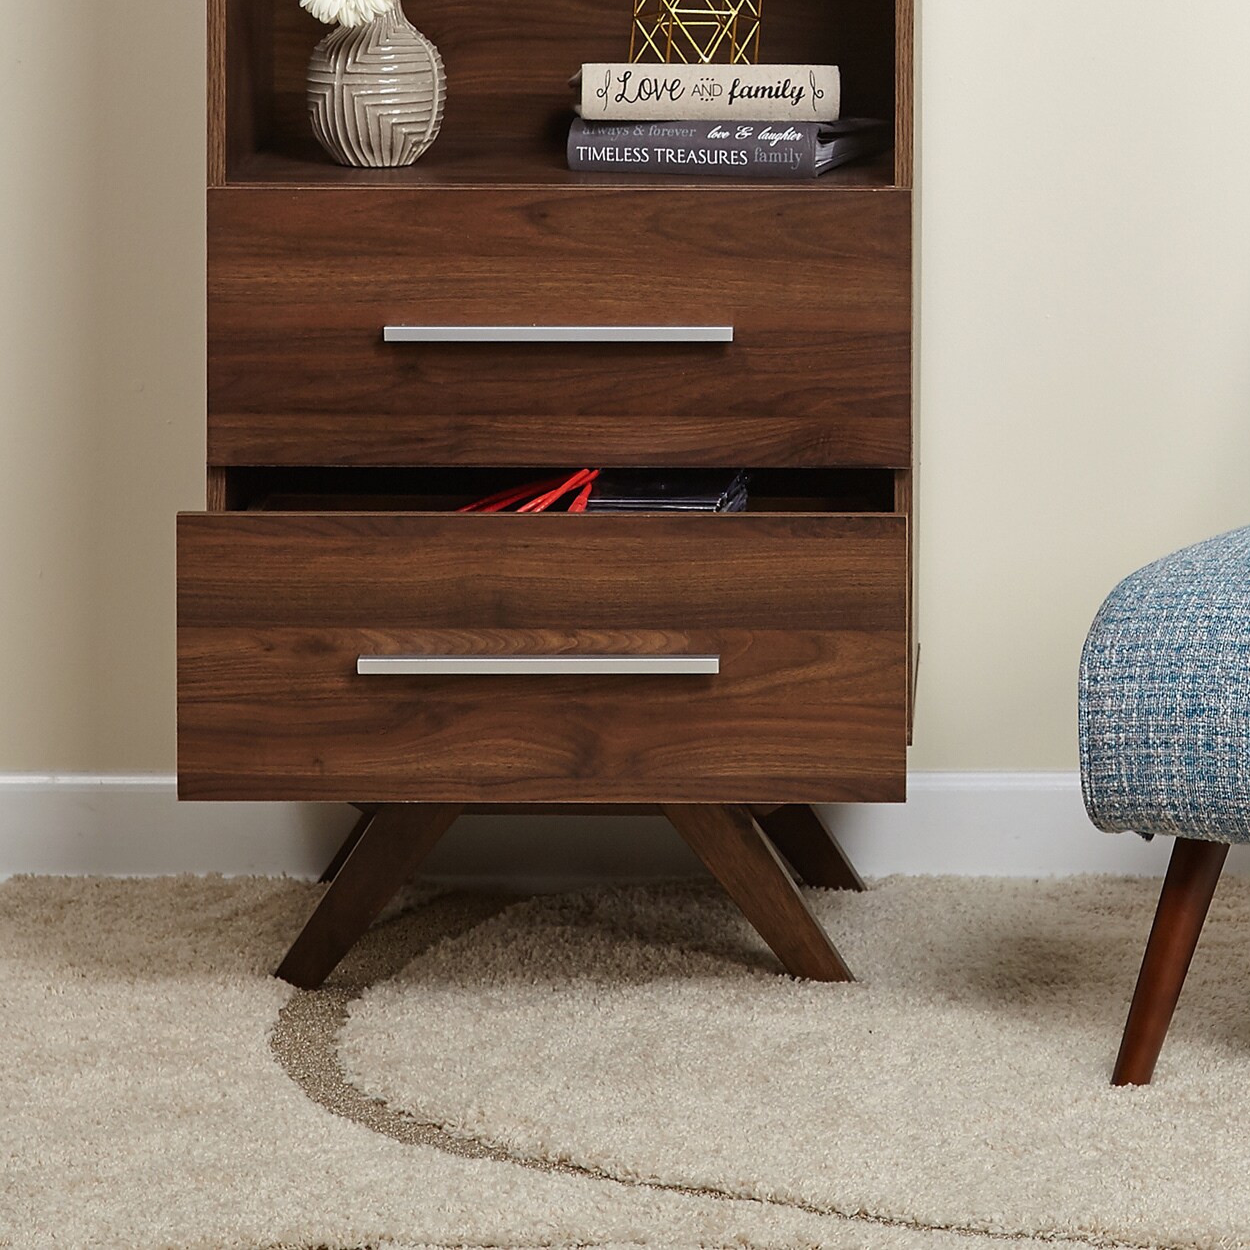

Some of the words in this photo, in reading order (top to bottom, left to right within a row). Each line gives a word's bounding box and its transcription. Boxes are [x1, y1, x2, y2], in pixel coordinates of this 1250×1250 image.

[615, 71, 685, 104] Love
[691, 83, 723, 97] AND
[728, 78, 806, 105] family
[633, 125, 645, 136] &
[649, 124, 697, 137] forever
[707, 125, 730, 139] love
[735, 125, 754, 140] &
[757, 126, 803, 147] laughter
[576, 146, 650, 163] TIMELESS
[653, 148, 748, 165] TREASURES
[753, 146, 803, 170] family
